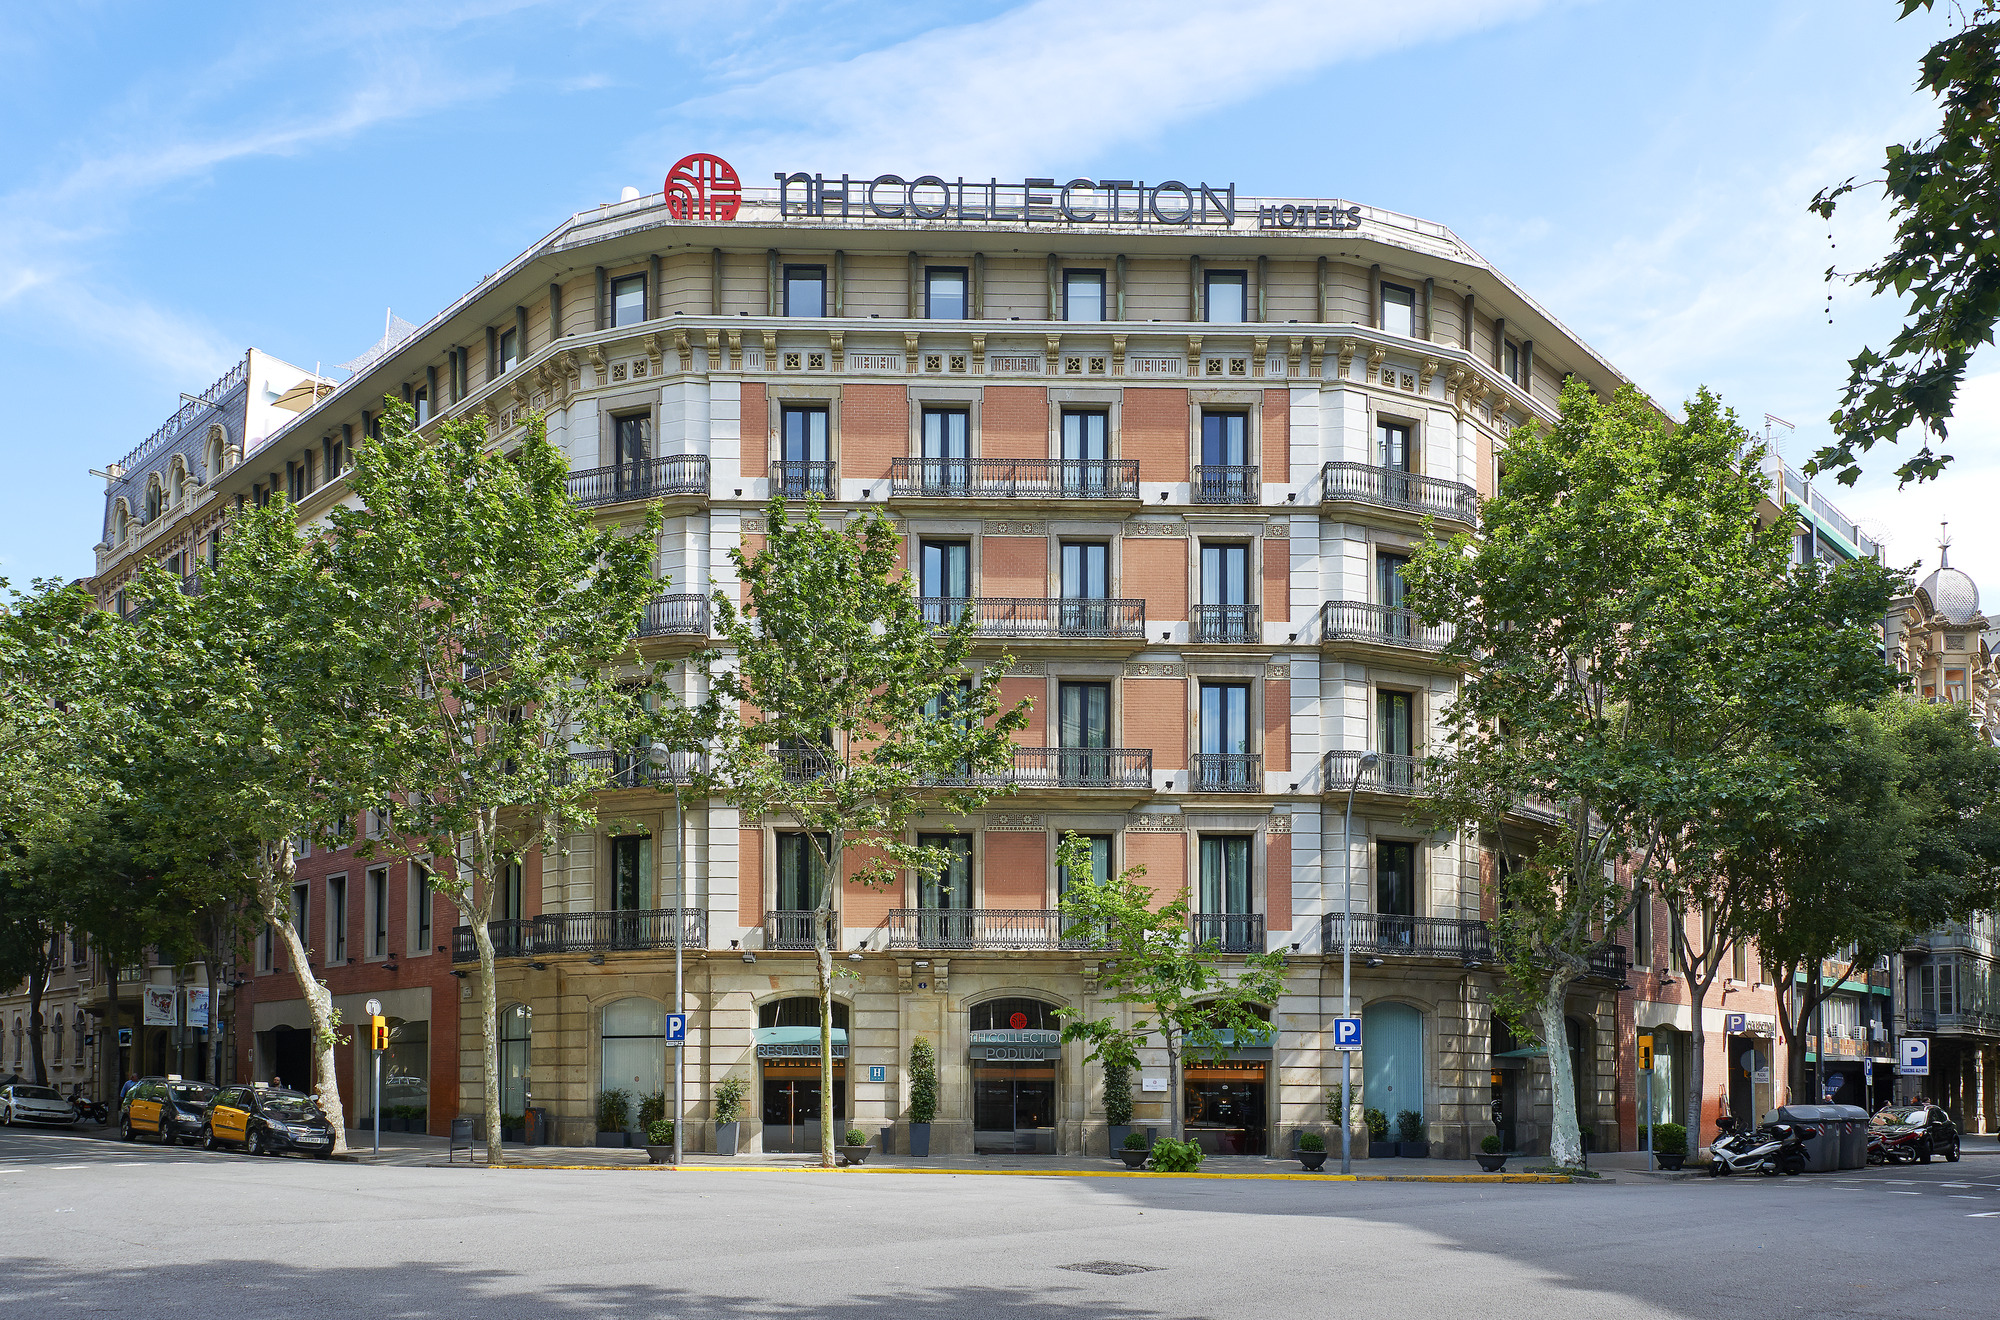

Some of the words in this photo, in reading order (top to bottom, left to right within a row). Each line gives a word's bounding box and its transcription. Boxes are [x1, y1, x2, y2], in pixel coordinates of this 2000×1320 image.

[868, 174, 1235, 225] COLLECTION
[1259, 204, 1362, 229] HOTELS
[669, 1017, 682, 1038] P
[1730, 1016, 1742, 1030] P
[1339, 1021, 1356, 1043] P
[757, 1045, 848, 1056] RESTAURNT
[986, 1047, 1045, 1059] PODIUM
[1902, 1040, 1927, 1066] P
[873, 1067, 881, 1077] H
[1866, 1059, 1871, 1074] P
